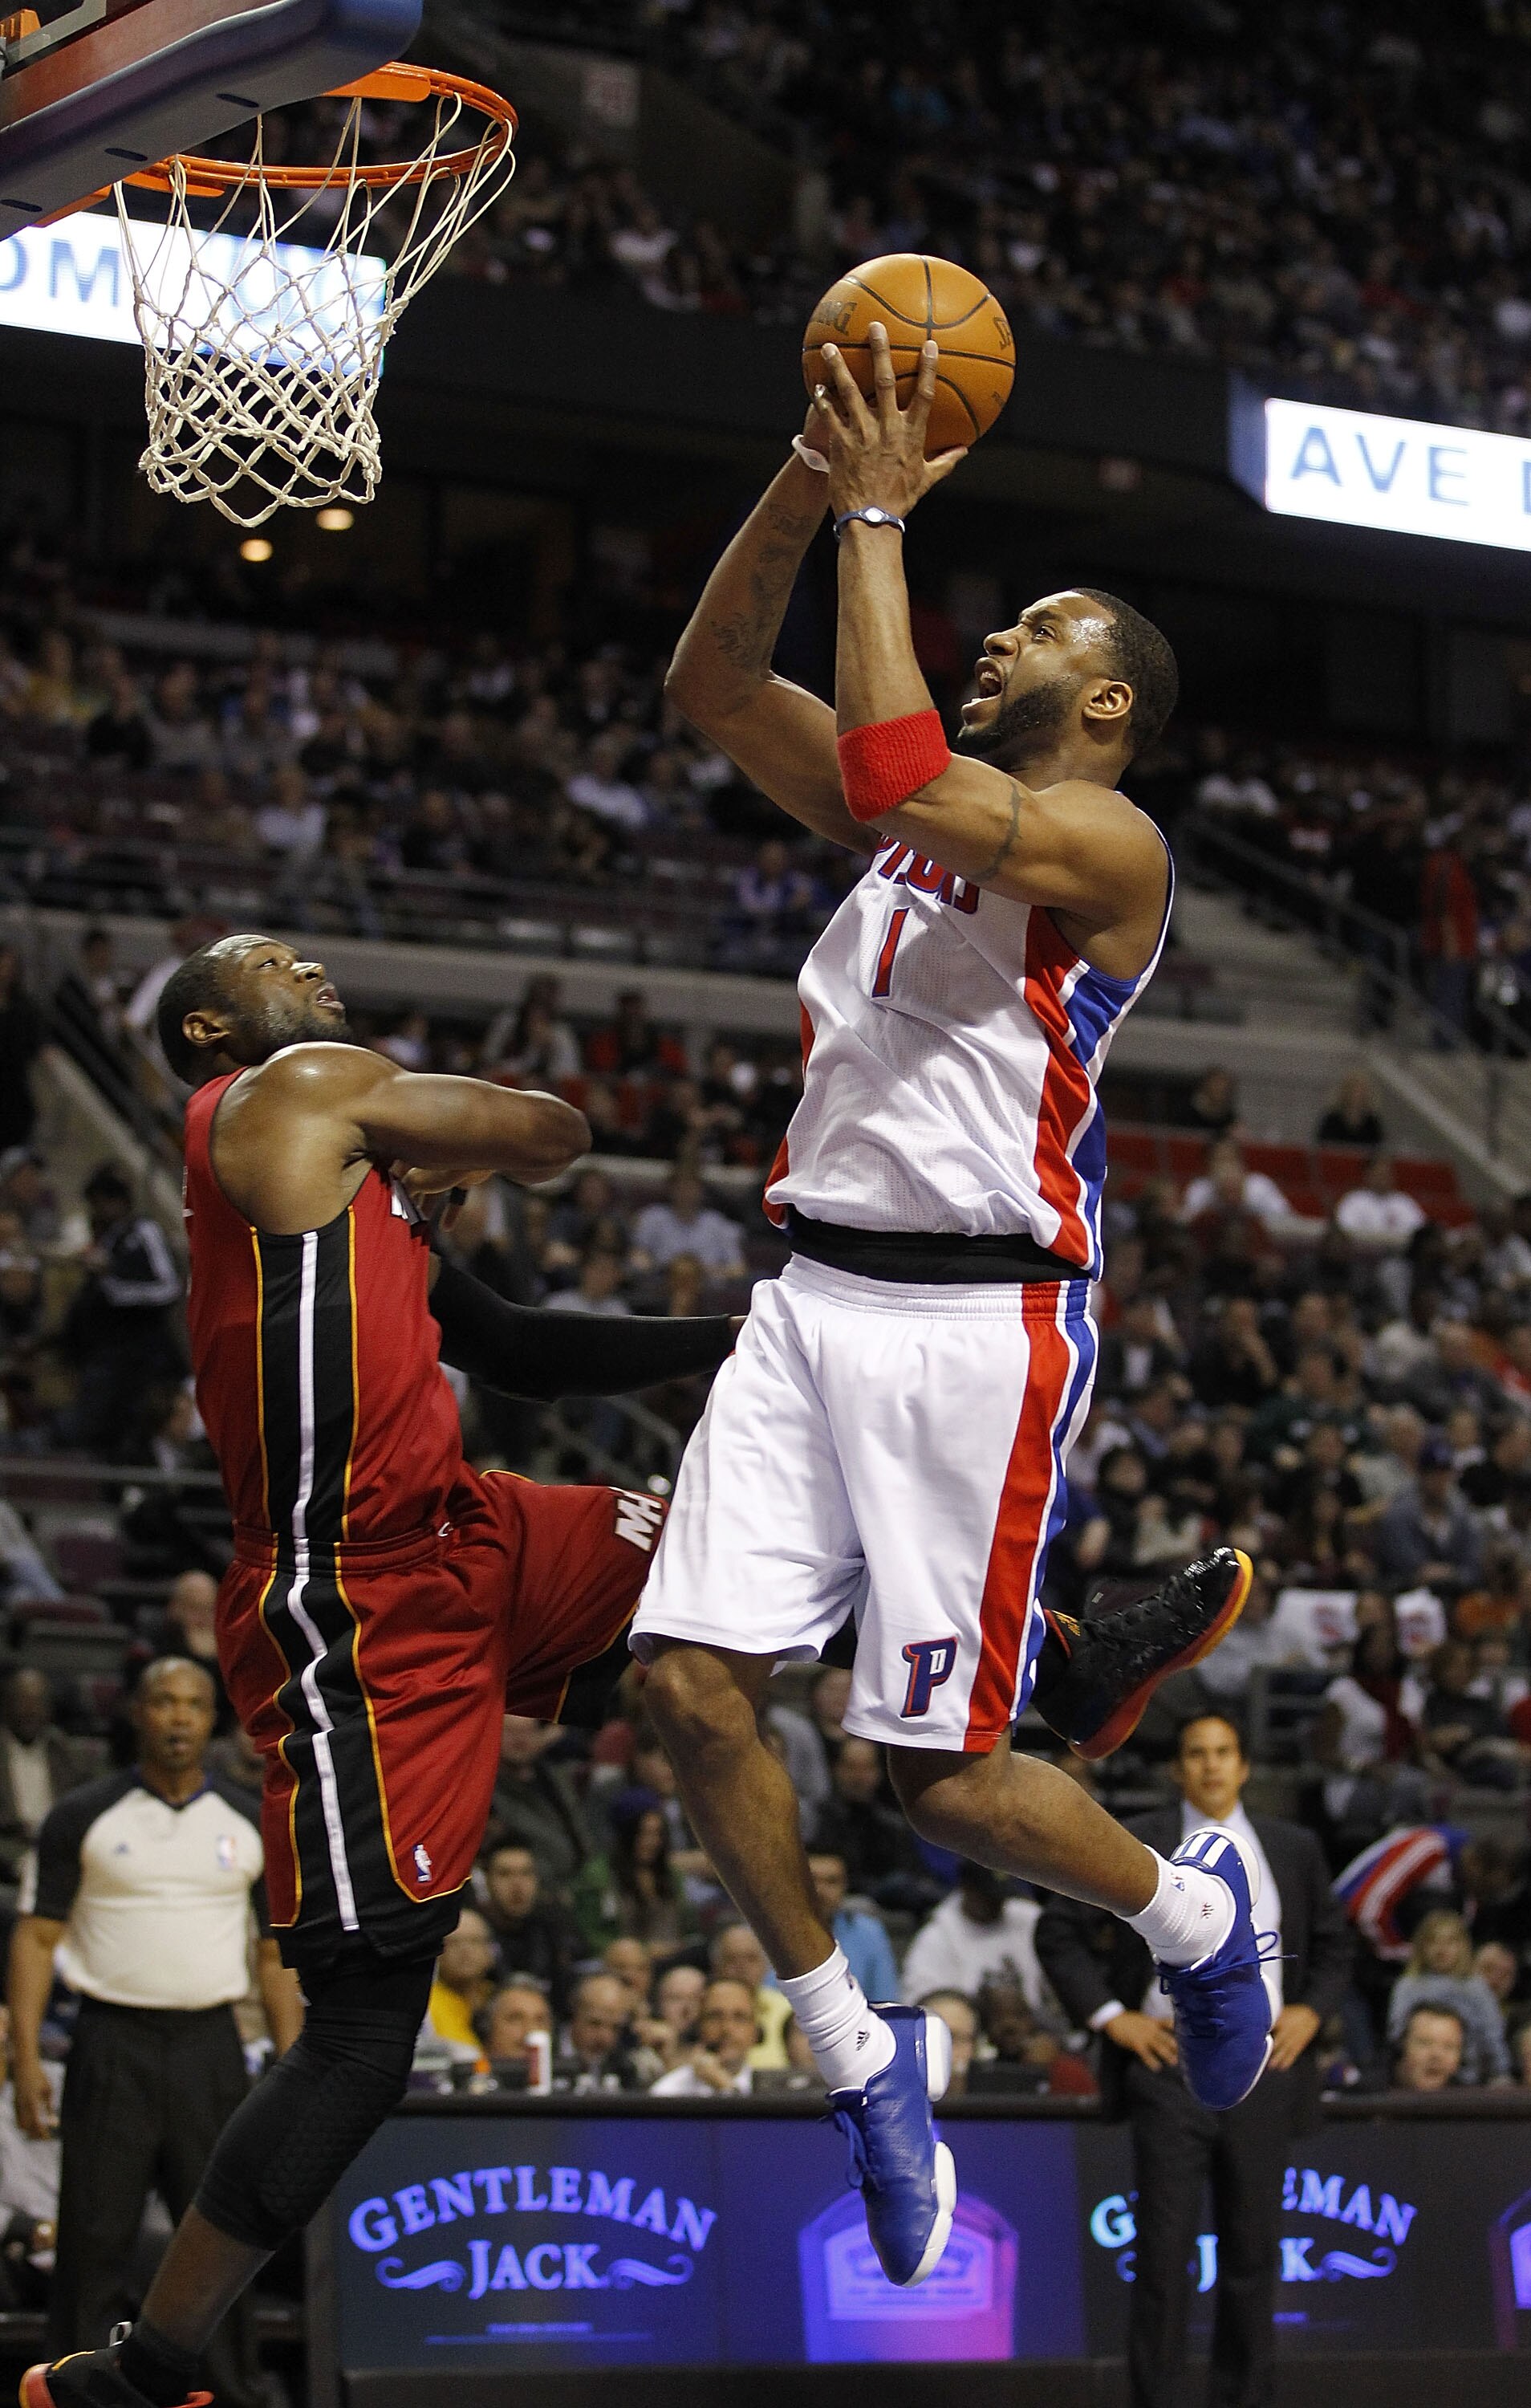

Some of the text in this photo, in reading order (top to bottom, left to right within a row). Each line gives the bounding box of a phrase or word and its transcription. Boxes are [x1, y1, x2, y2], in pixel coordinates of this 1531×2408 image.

[1291, 426, 1469, 506] AVE
[871, 908, 911, 997] 1
[349, 2166, 716, 2251] GENTLEMAN
[467, 2239, 610, 2300] JACK
[1196, 2234, 1324, 2292] JK
